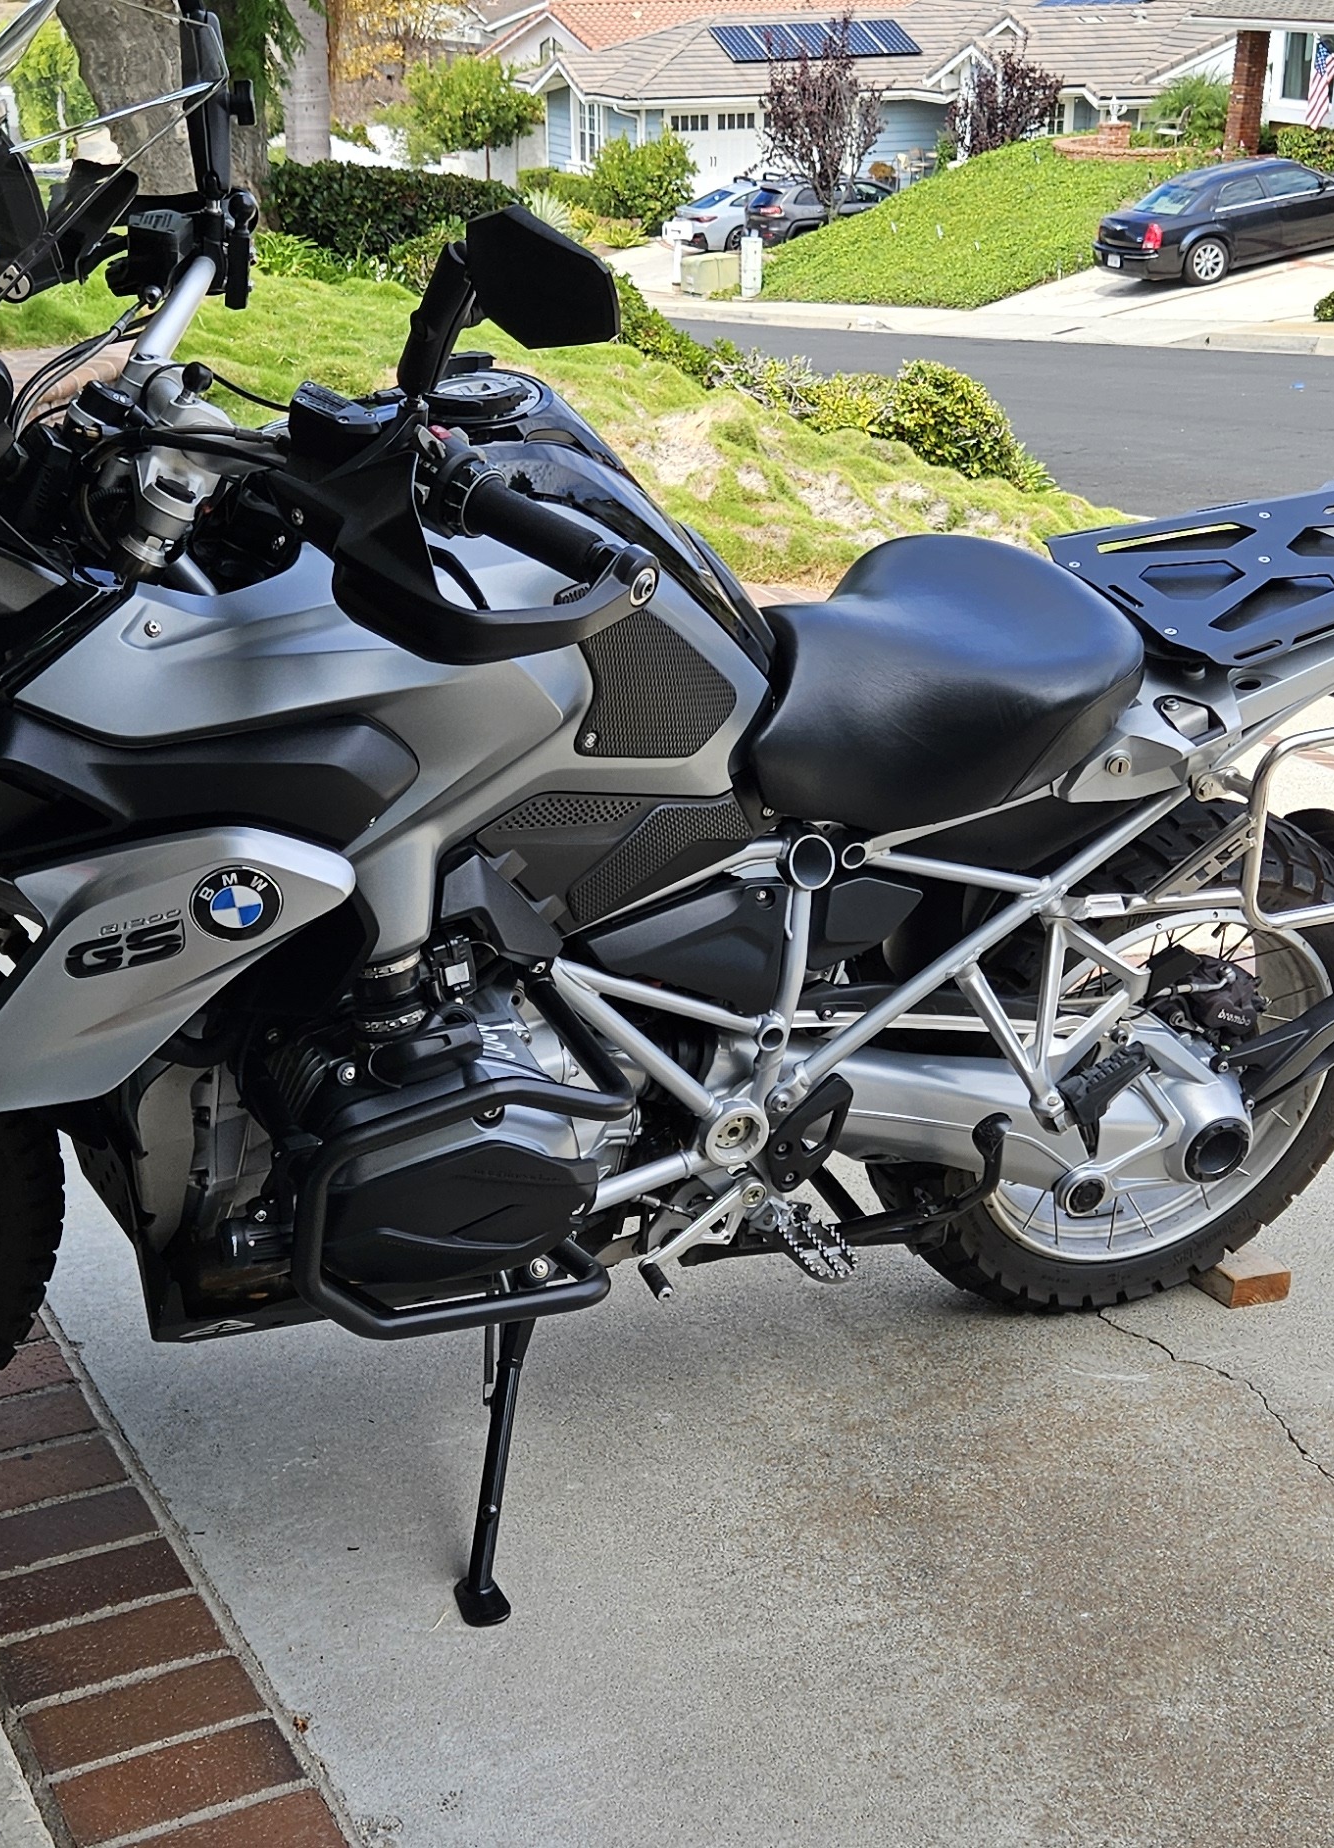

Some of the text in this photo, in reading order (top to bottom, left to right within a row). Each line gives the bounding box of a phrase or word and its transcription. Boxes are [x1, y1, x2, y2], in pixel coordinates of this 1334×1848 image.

[197, 871, 269, 902] BMW
[98, 908, 182, 937] R1200
[65, 919, 187, 979] GS
[1217, 1008, 1252, 1026] brembo
